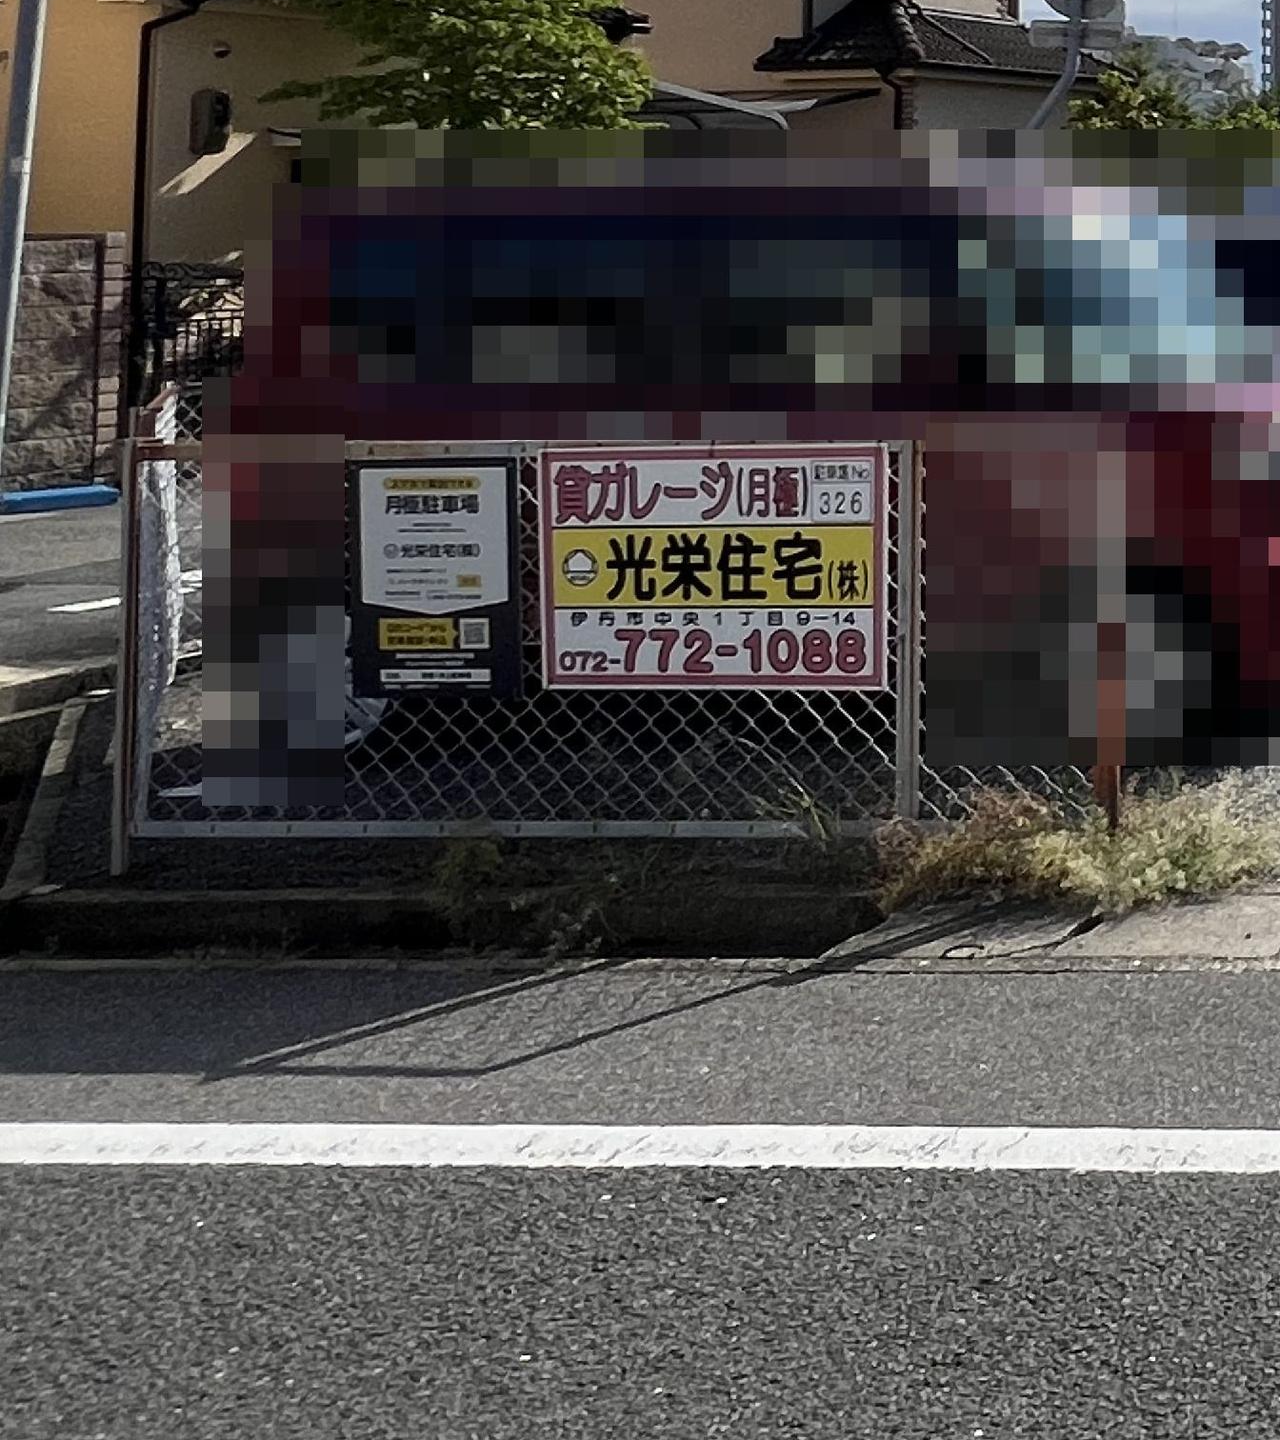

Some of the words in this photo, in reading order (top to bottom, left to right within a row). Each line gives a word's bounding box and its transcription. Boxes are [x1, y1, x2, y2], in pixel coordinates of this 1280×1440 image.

[820, 491, 863, 515] 326
[606, 531, 868, 601] 光栄住宅(株)
[559, 628, 867, 674] 072-772-1088
